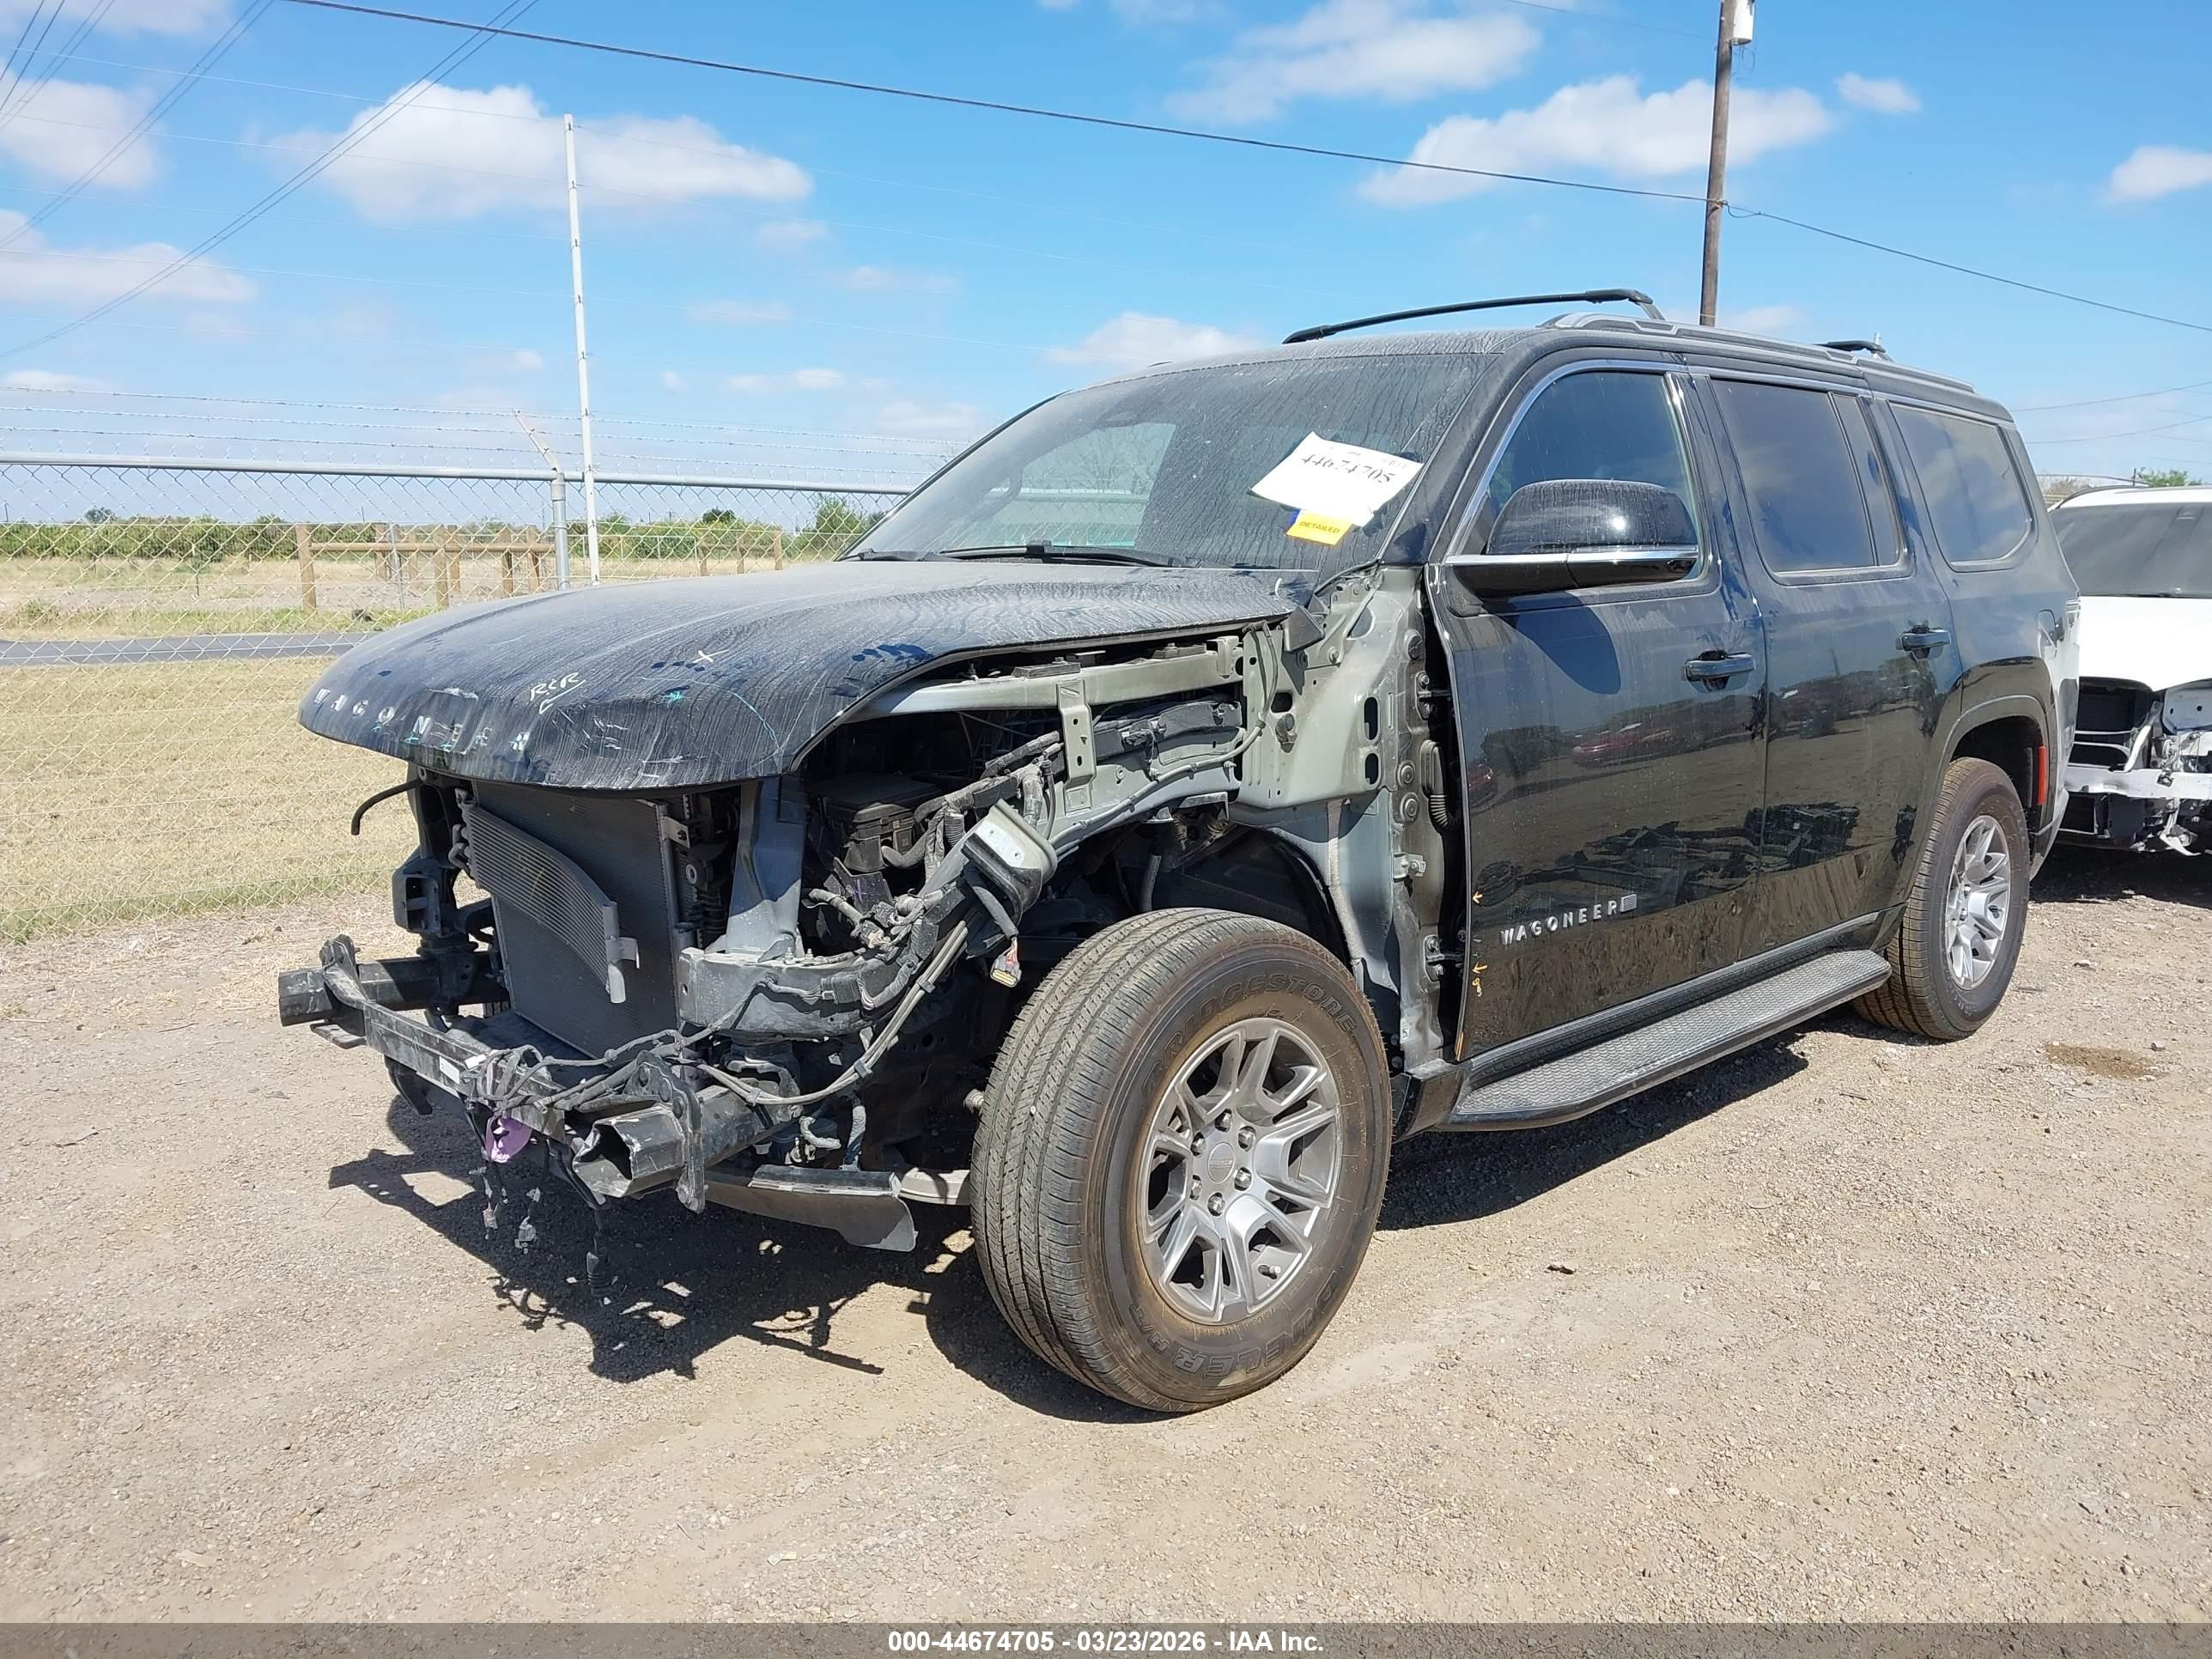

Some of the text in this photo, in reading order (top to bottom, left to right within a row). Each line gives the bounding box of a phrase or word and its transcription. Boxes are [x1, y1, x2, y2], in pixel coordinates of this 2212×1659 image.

[1299, 521, 1340, 533] DETAILED
[1500, 899, 1618, 945] WAGONEER
[1141, 972, 1358, 1096] BRIDGESTONE
